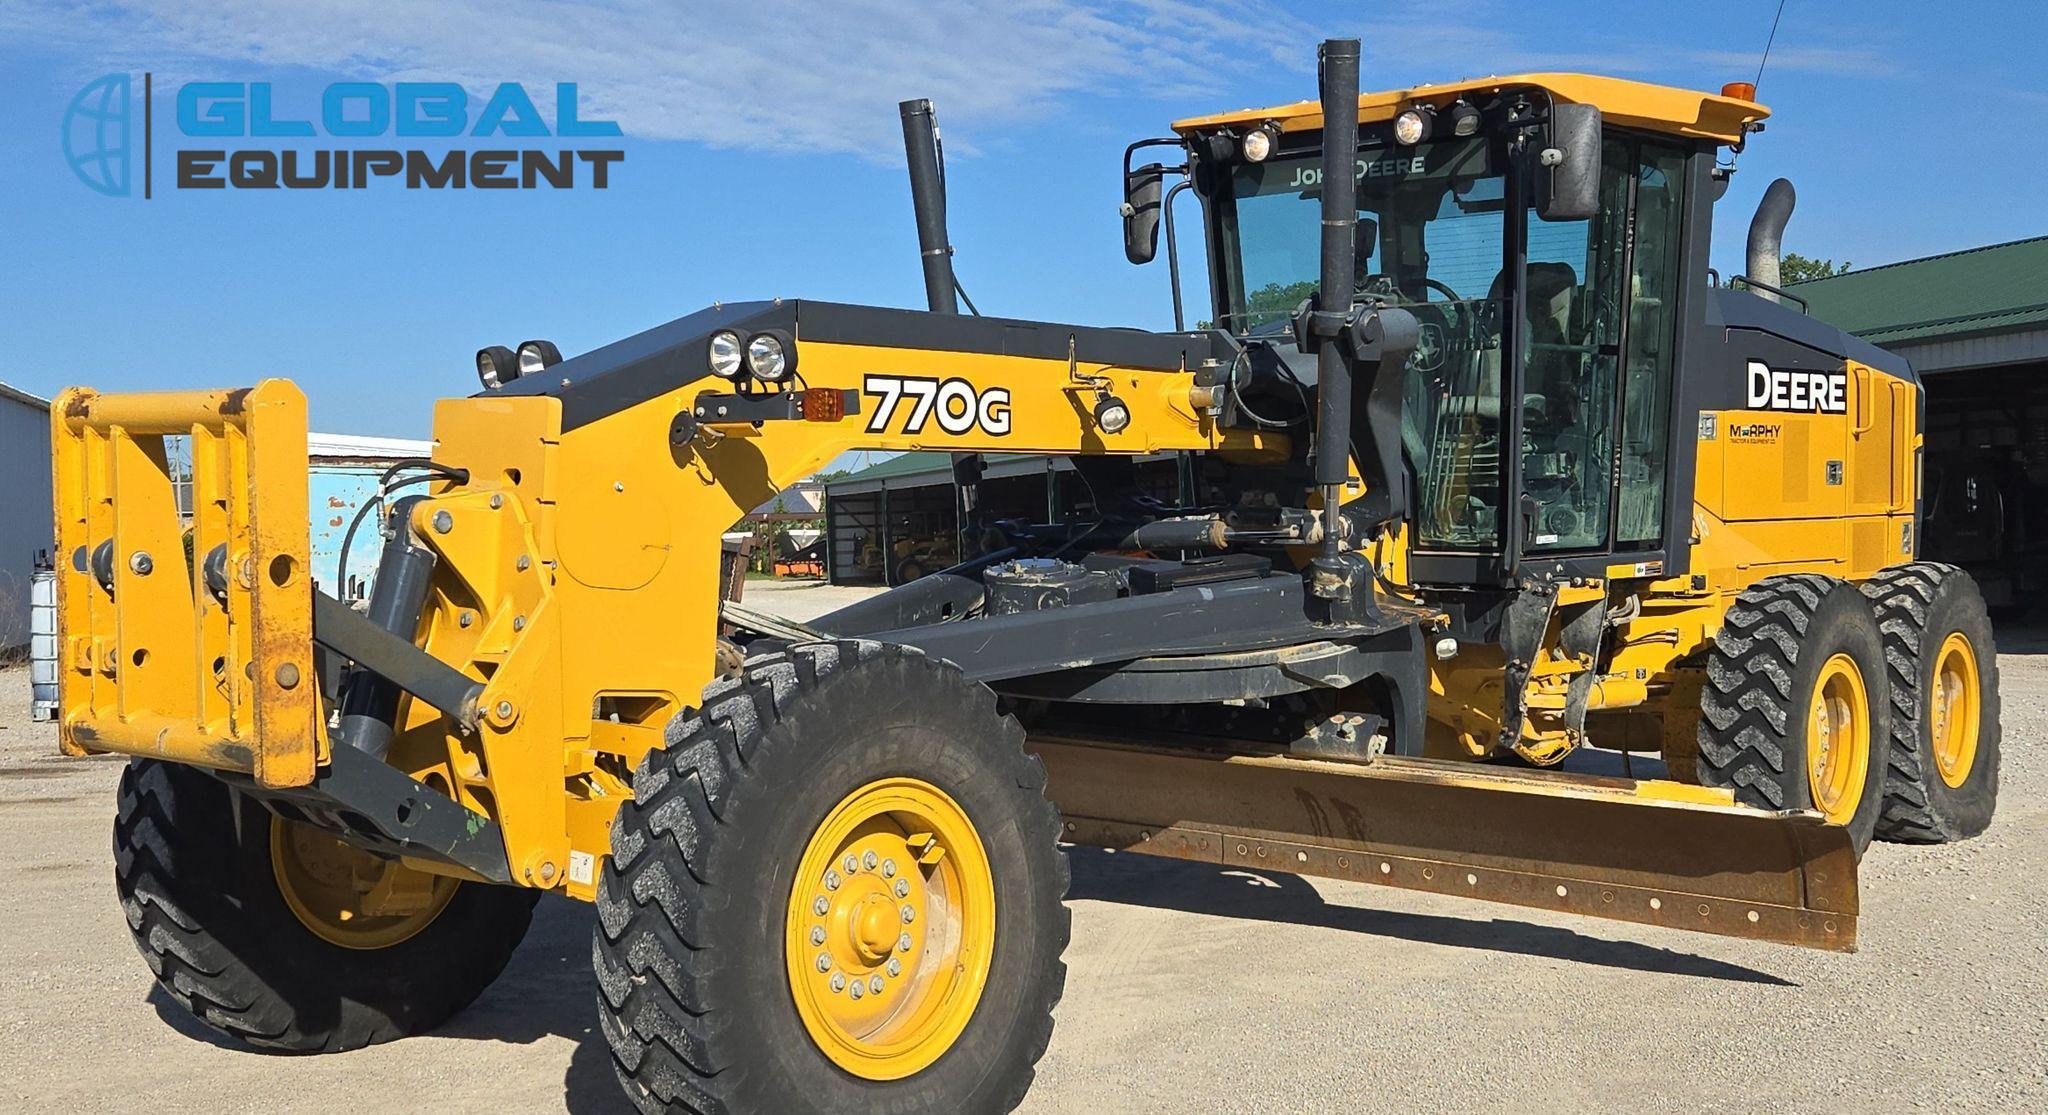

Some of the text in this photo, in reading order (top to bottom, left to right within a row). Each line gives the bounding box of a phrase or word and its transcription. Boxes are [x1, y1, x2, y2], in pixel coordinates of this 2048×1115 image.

[1290, 167, 1323, 187] JO
[1746, 361, 1846, 411] DEERE
[864, 374, 1011, 436] 770G
[1729, 424, 1781, 438] MRPHY
